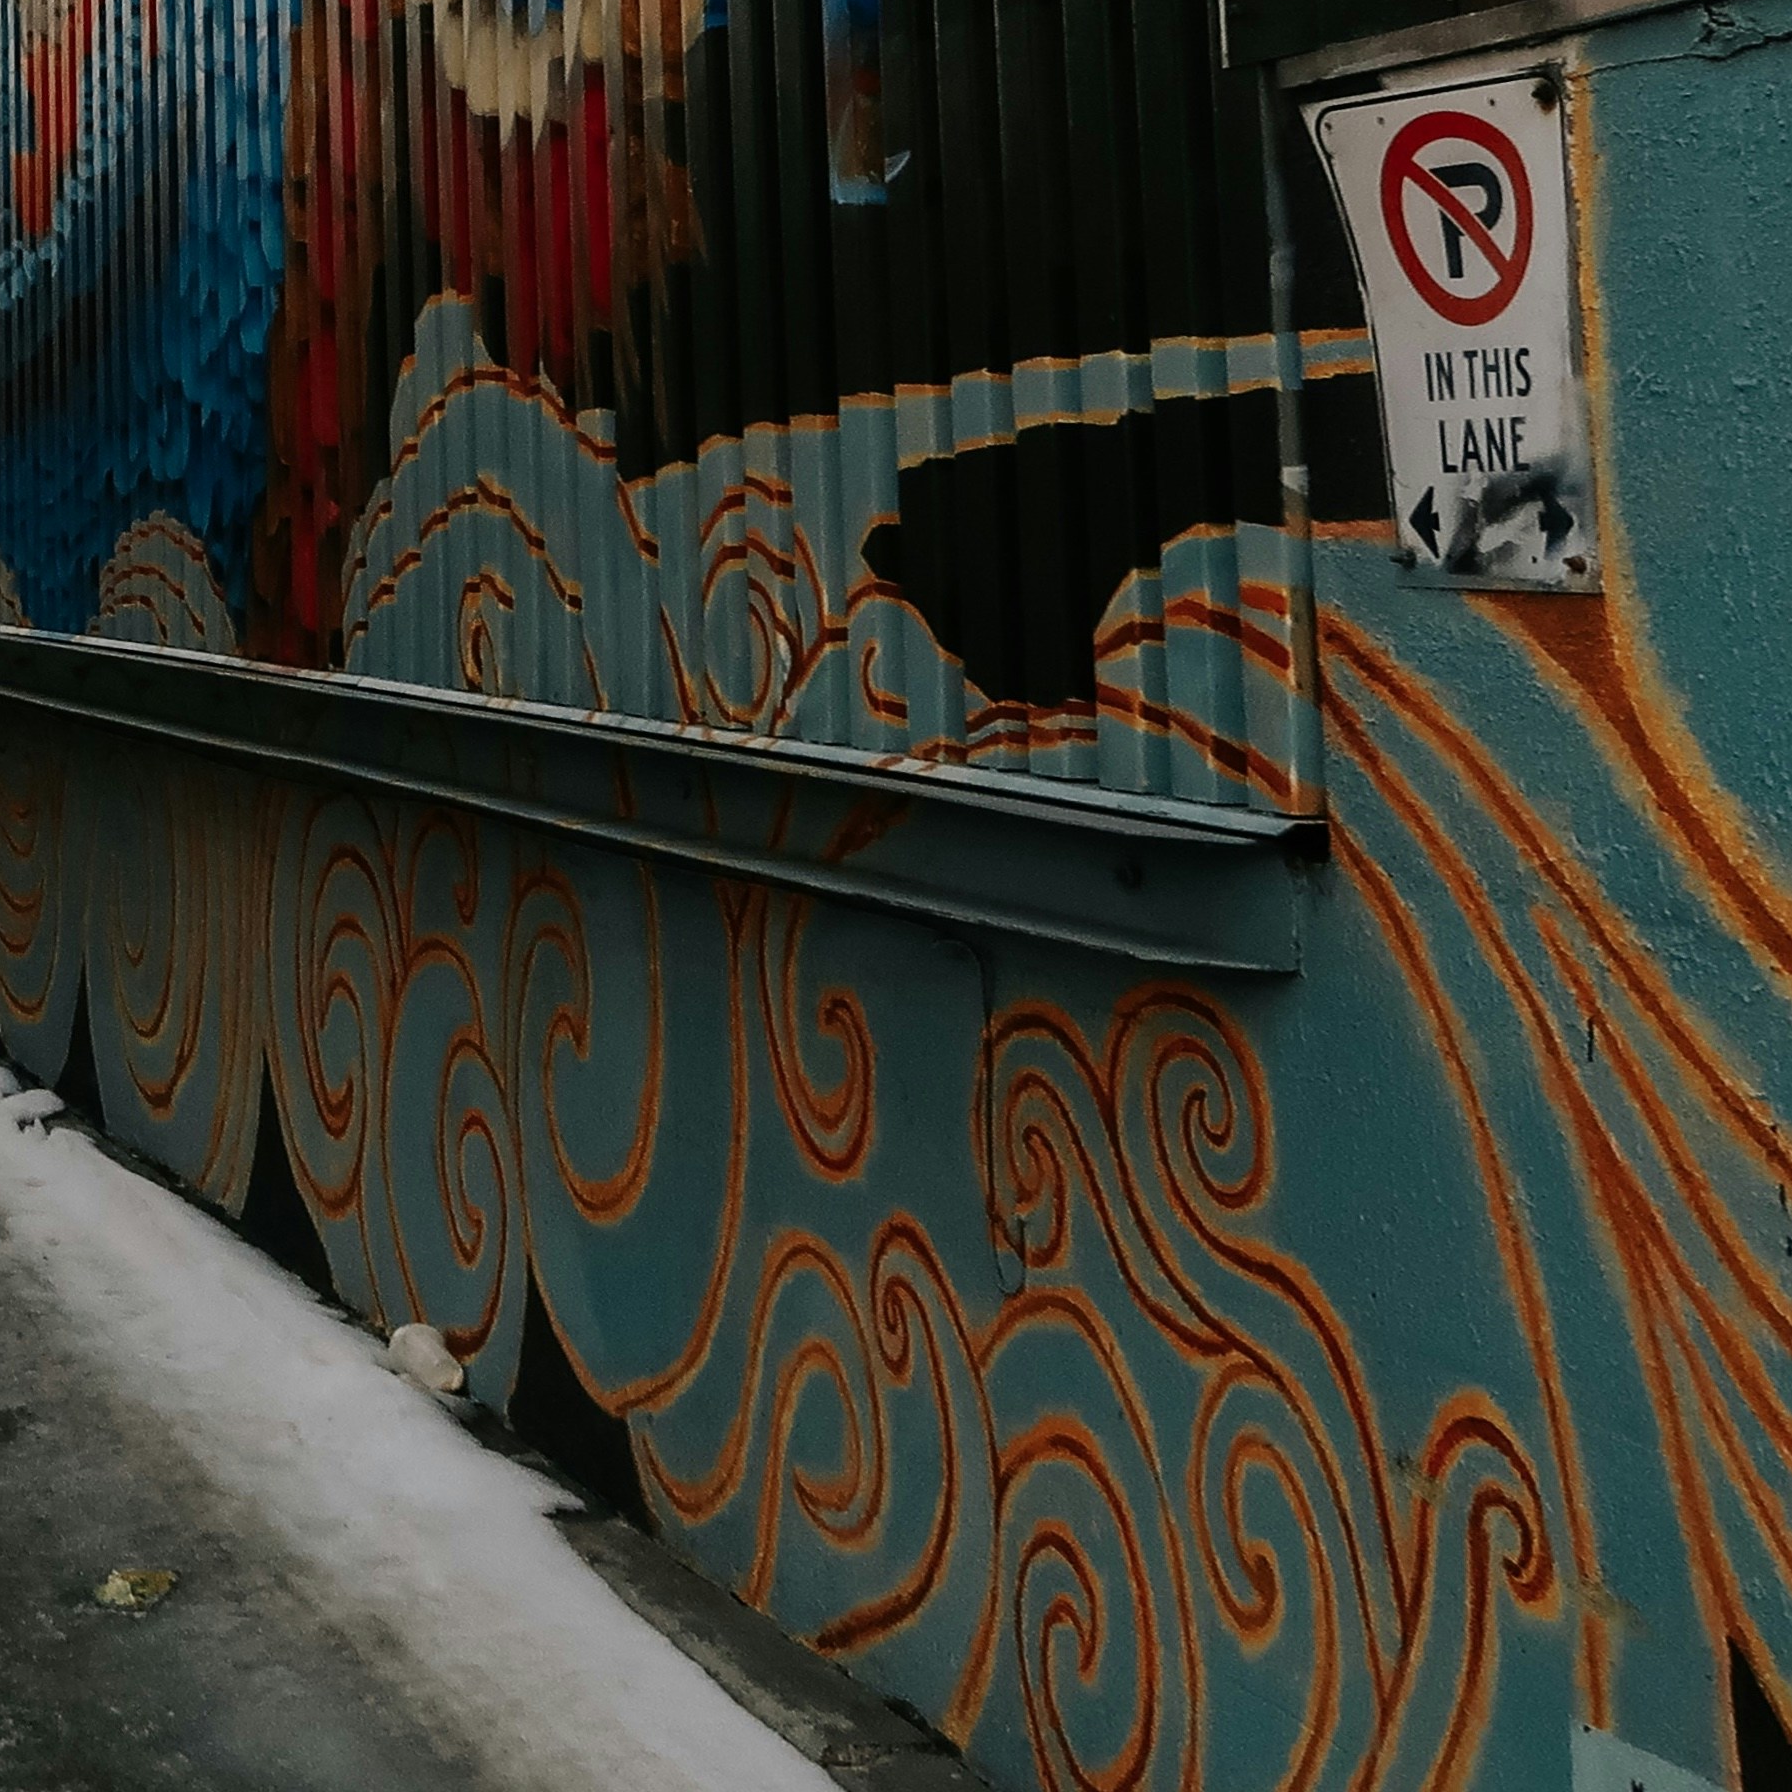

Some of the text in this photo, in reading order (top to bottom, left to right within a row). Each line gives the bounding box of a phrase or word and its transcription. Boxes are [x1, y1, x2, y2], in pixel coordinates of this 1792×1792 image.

[1425, 347, 1531, 402] IN THIS
[1439, 416, 1529, 473] LANE
